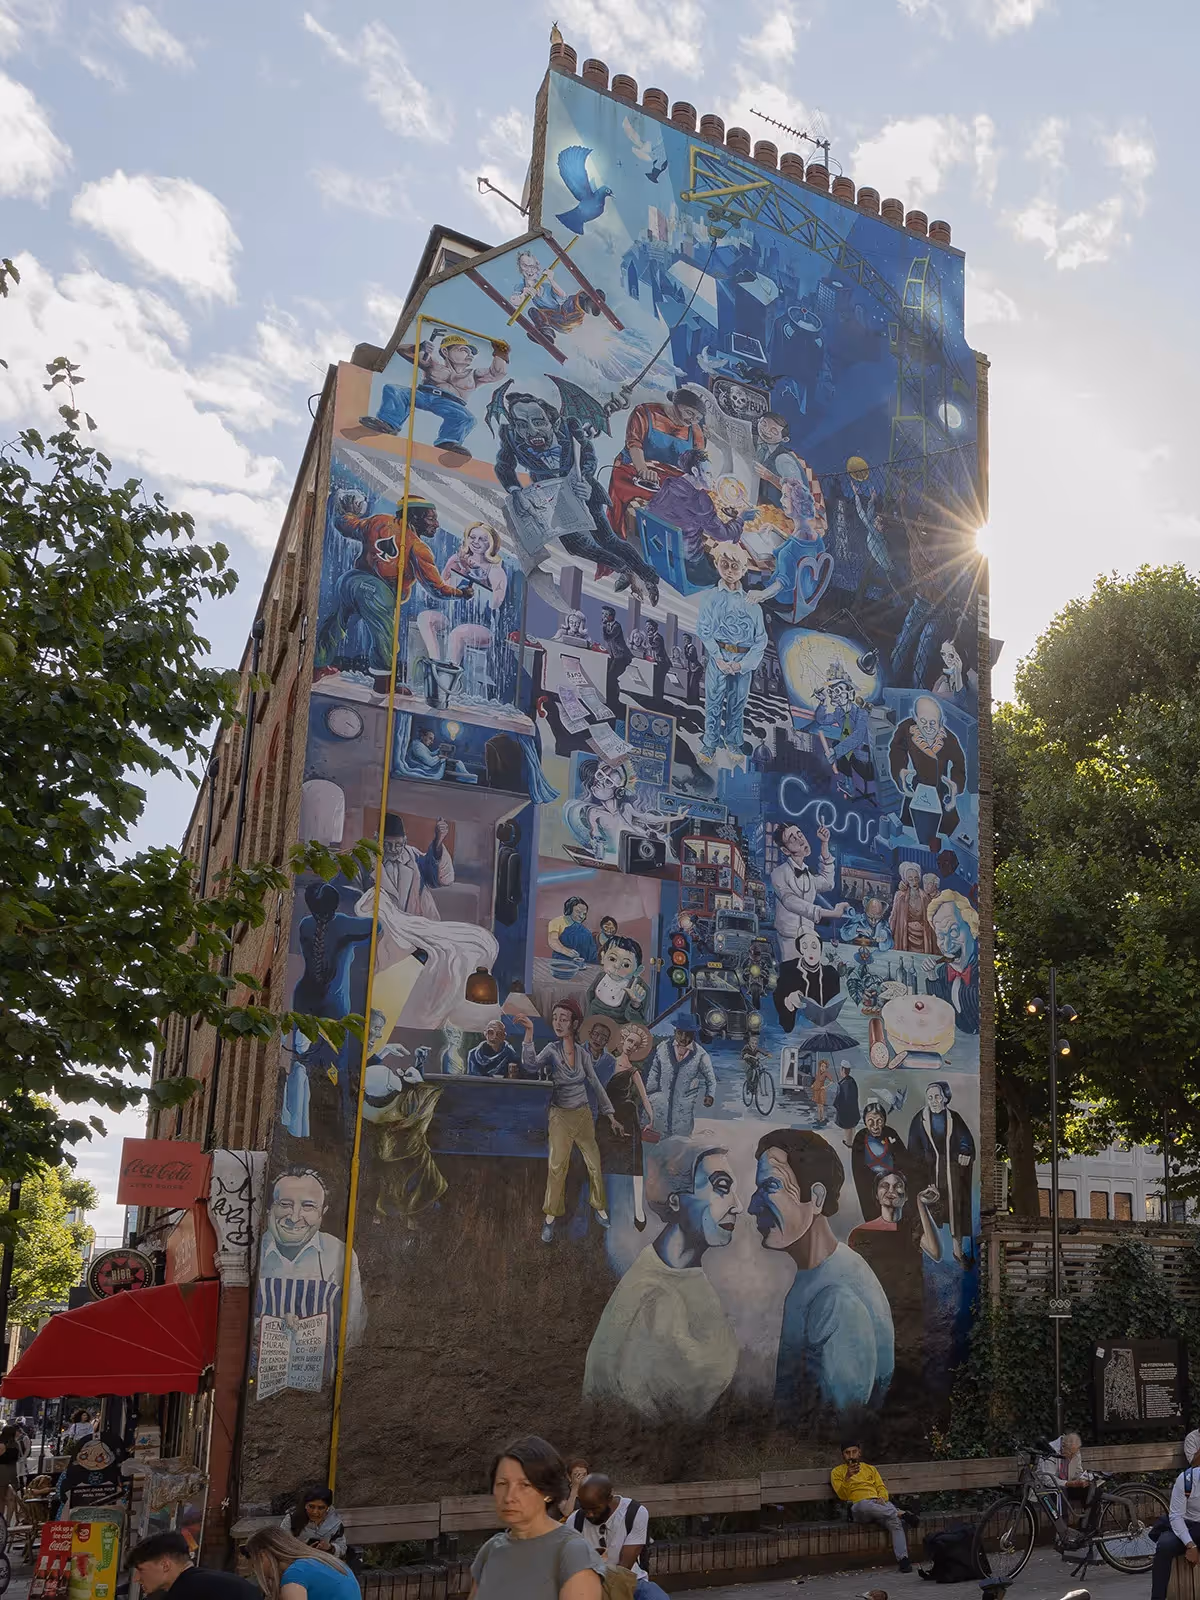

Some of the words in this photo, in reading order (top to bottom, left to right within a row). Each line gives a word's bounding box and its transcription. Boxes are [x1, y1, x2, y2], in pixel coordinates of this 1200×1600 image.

[122, 1159, 193, 1181] Coca-Cola
[302, 1329, 316, 1338] ART
[262, 1341, 286, 1350] MURAL
